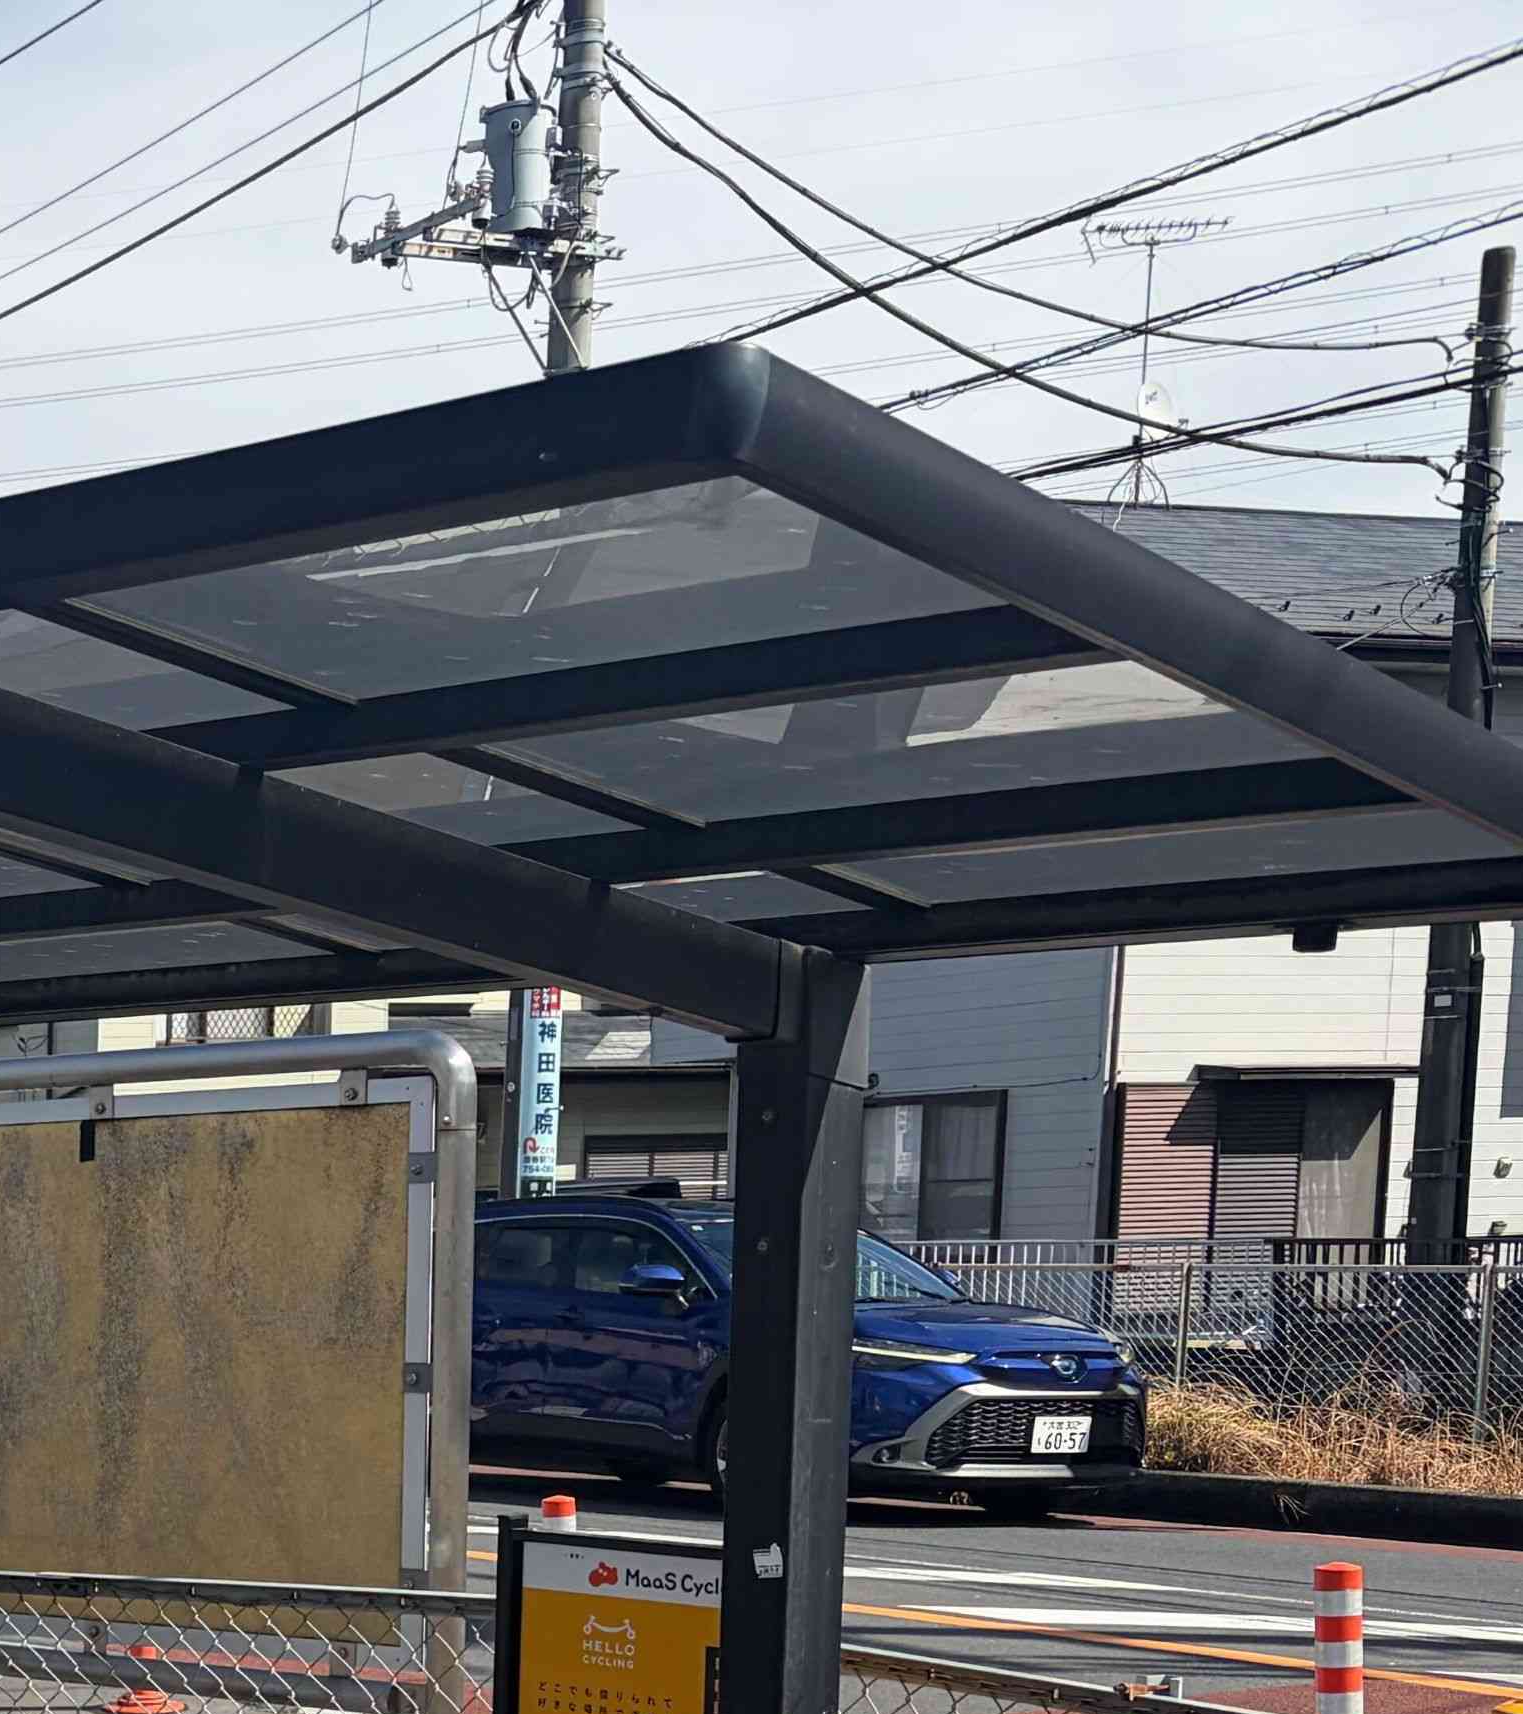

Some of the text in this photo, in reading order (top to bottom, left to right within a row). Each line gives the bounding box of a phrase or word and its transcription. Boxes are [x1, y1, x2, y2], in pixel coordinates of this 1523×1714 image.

[535, 1021, 557, 1135] 神田医院
[1044, 1432, 1088, 1450] 60-57
[625, 1568, 723, 1598] MaaS Cycl
[582, 1639, 635, 1656] HELLO
[582, 1654, 634, 1670] CYCLING
